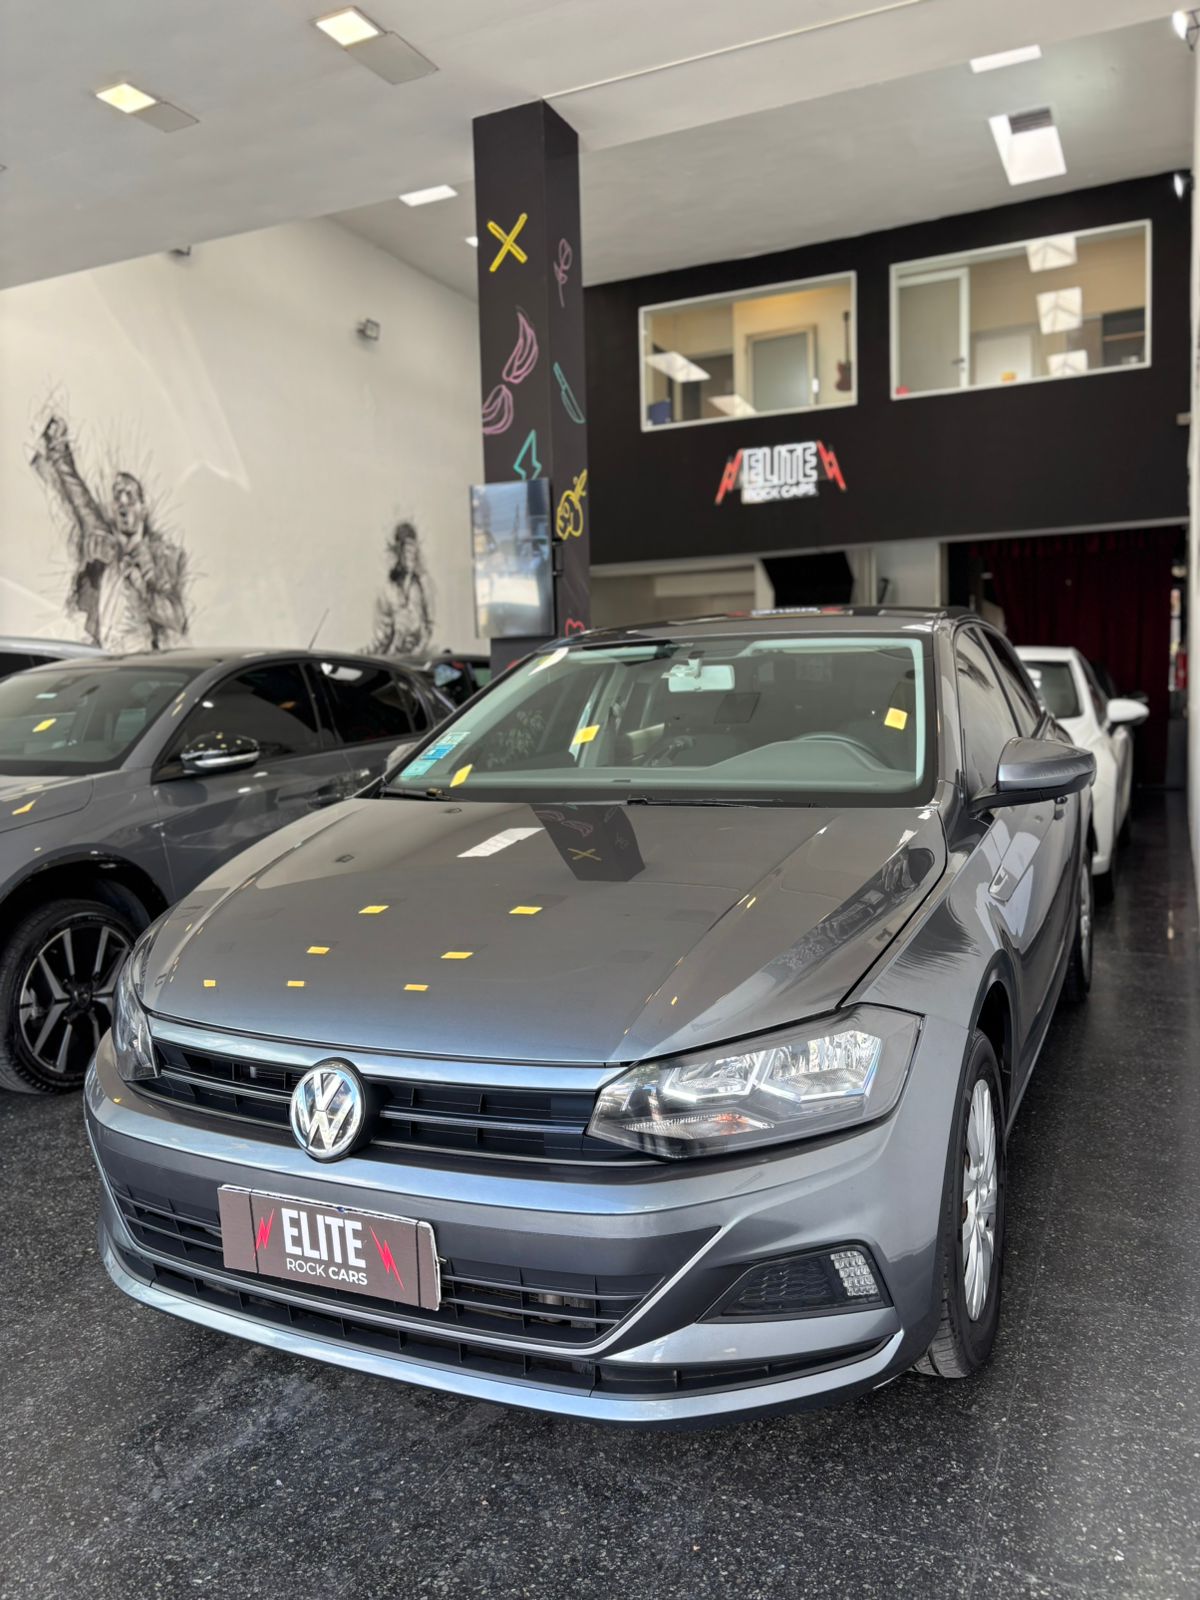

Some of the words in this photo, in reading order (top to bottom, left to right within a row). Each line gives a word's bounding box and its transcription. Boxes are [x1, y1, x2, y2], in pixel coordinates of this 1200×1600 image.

[742, 441, 818, 487] ELITE
[780, 481, 819, 499] CARS
[281, 1207, 367, 1269] ELITE
[286, 1257, 326, 1279] ROCK
[328, 1266, 368, 1286] CARS
